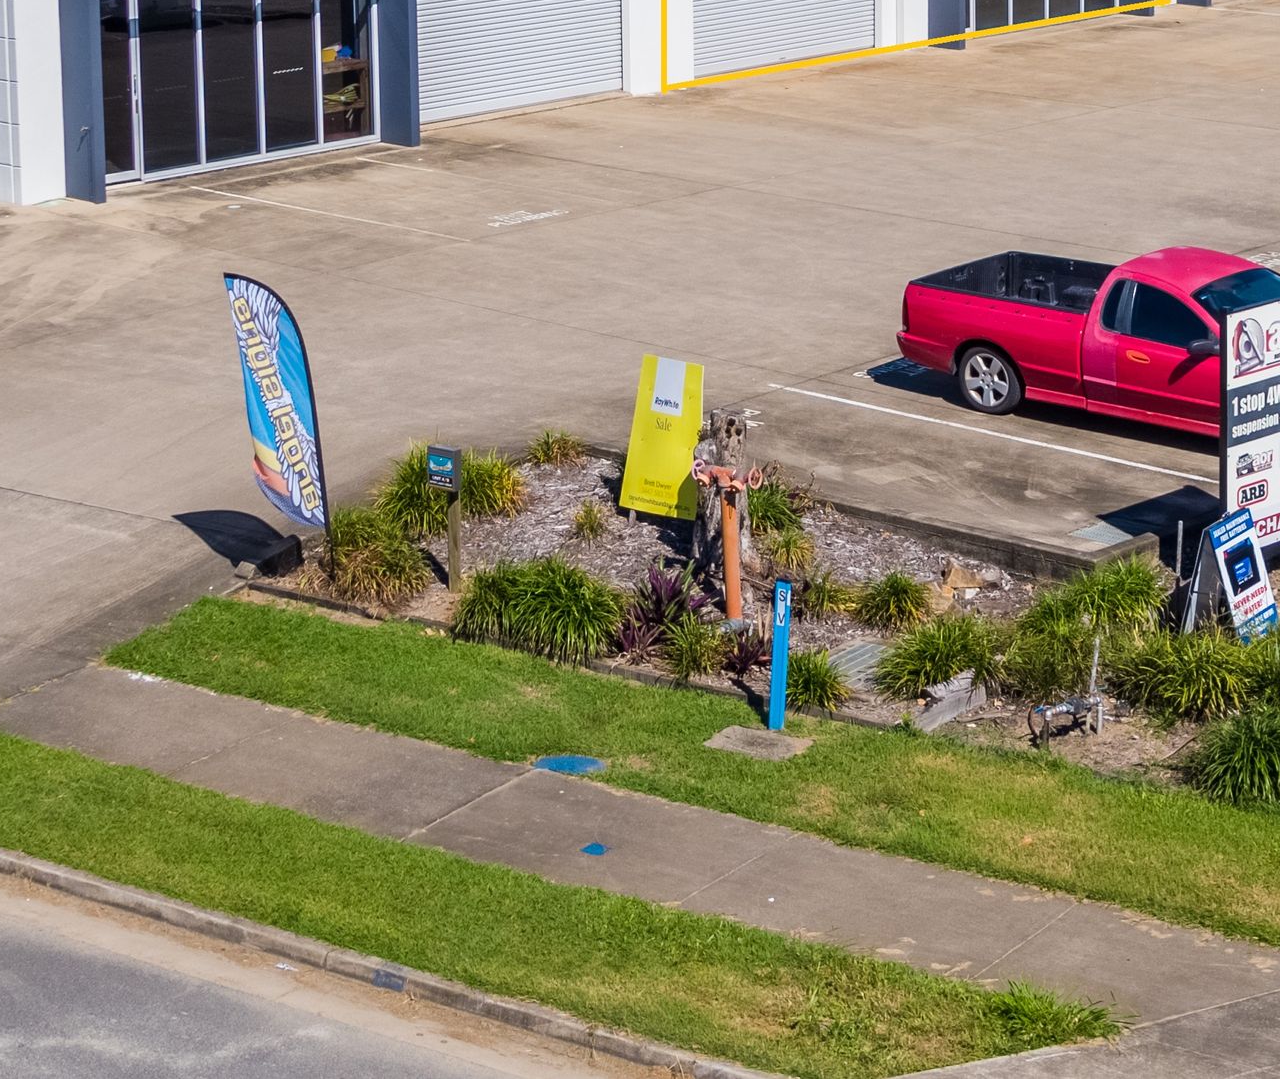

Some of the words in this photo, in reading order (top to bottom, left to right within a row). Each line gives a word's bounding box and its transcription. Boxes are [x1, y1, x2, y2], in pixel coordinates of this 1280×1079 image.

[1231, 396, 1239, 416] 1
[1239, 391, 1265, 415] stop
[655, 417, 673, 433] Sale
[1231, 412, 1279, 438] suspension
[1240, 483, 1266, 504] ARB
[1233, 595, 1250, 610] NEVER
